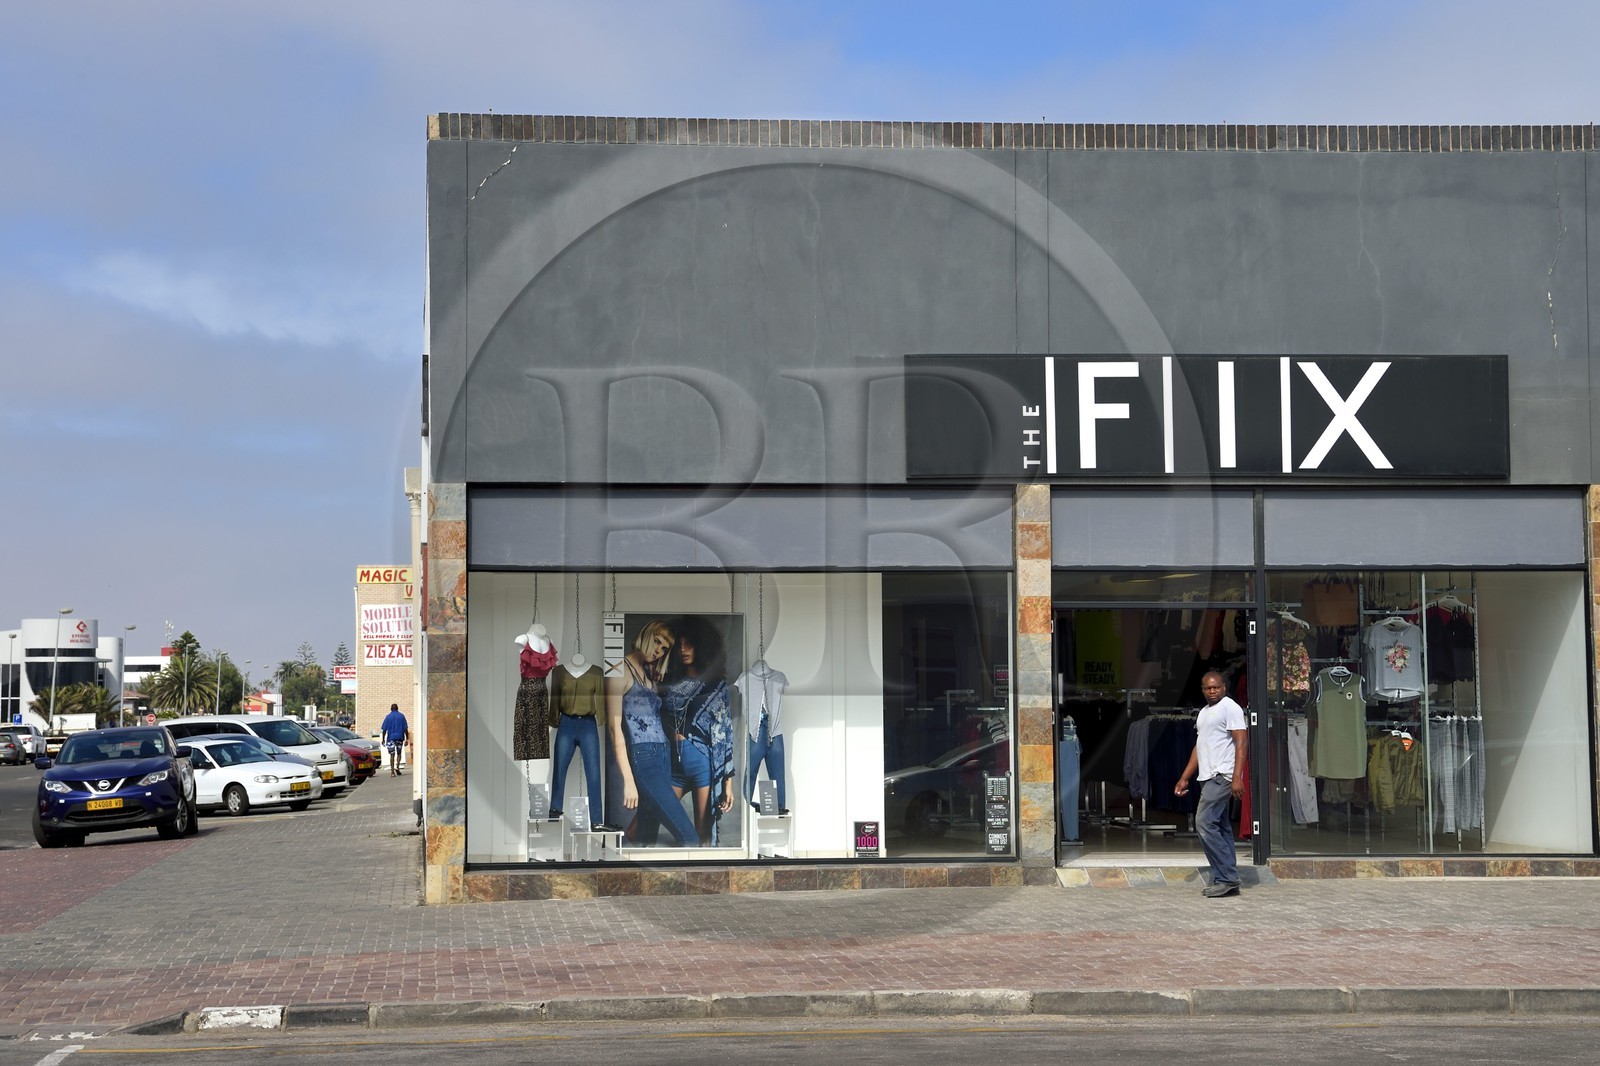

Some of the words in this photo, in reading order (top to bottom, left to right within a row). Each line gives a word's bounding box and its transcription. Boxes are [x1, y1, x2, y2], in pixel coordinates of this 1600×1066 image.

[1022, 405, 1040, 469] THE
[1078, 361, 1394, 469] FIX
[359, 569, 408, 582] MAGIC
[363, 605, 413, 621] MOBILE
[604, 622, 624, 675] FIX
[856, 836, 878, 847] 1000
